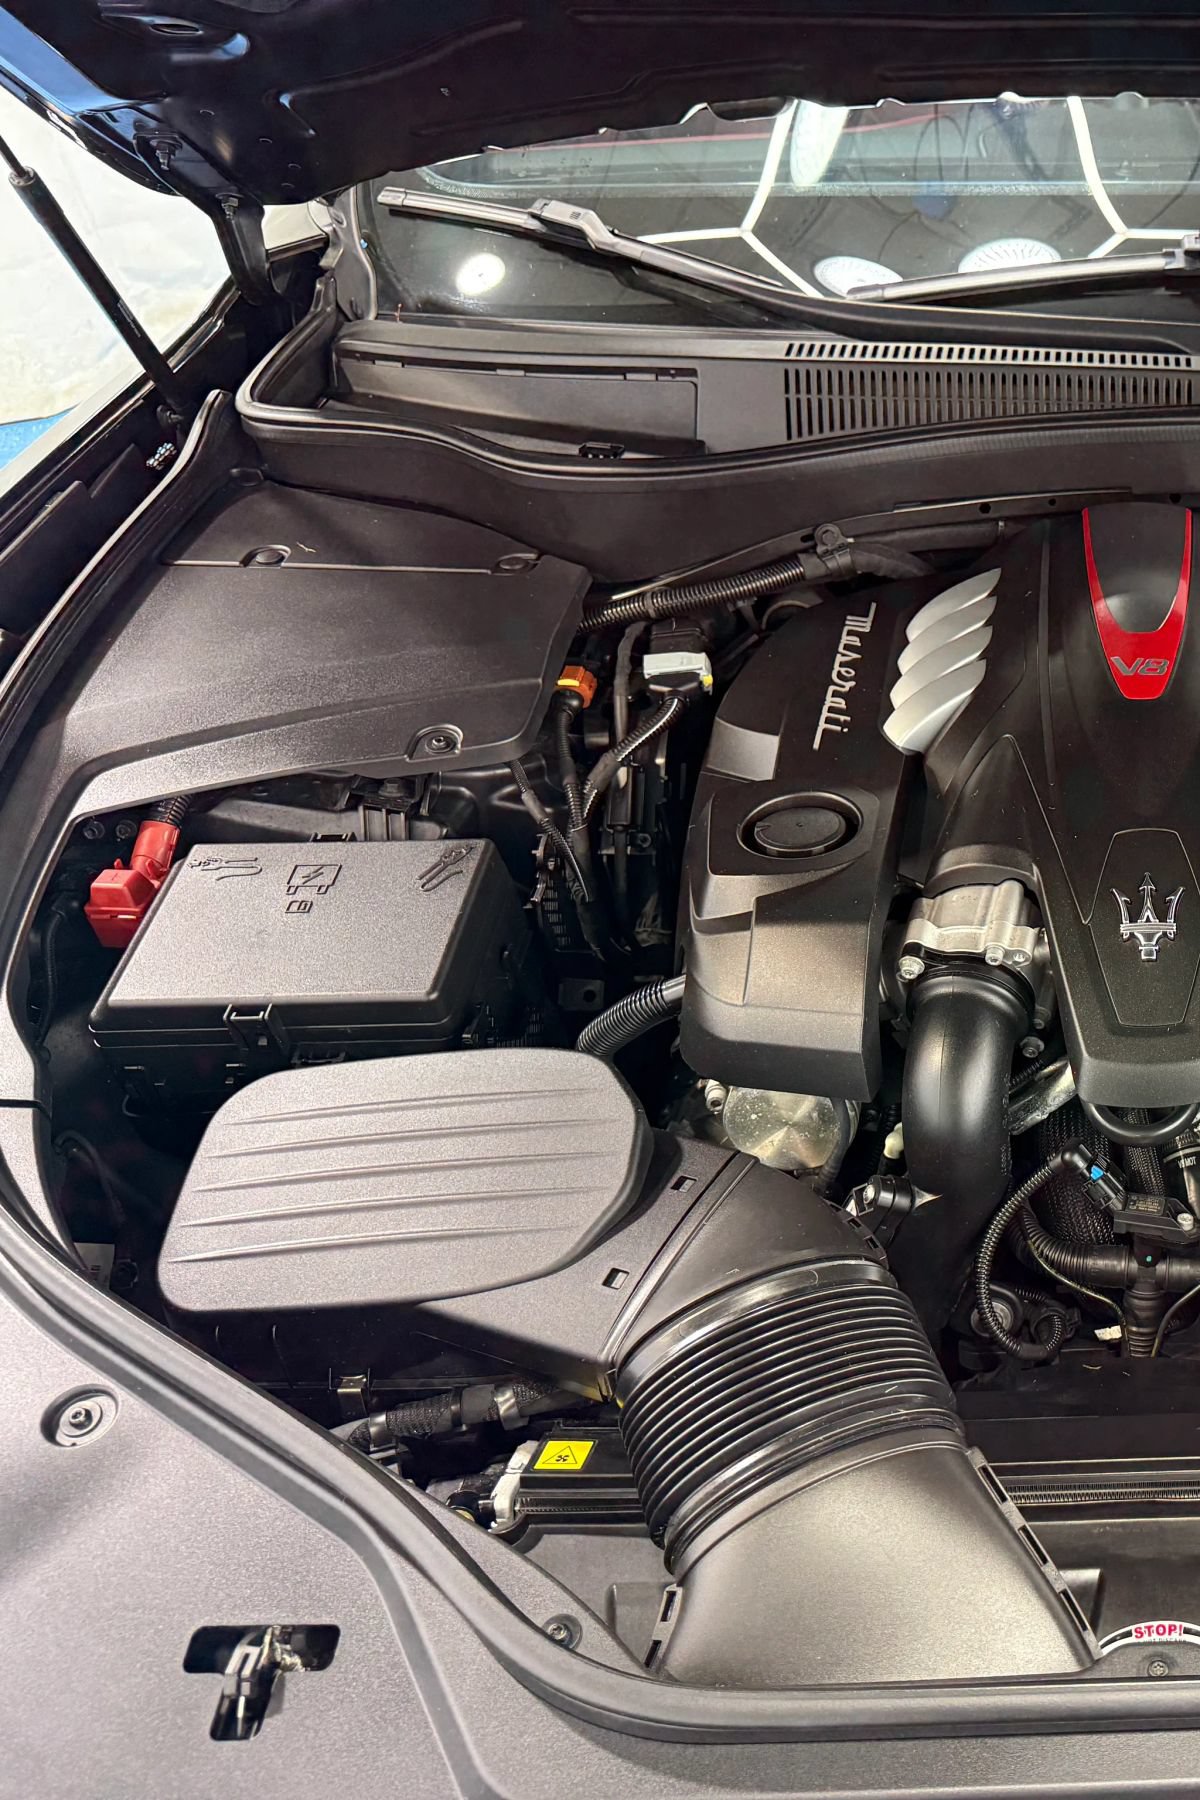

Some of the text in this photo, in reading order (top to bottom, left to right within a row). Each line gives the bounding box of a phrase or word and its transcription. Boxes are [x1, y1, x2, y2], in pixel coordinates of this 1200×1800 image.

[1110, 656, 1170, 676] V8
[813, 602, 877, 751] Maserati
[1134, 1623, 1183, 1639] STOP!
